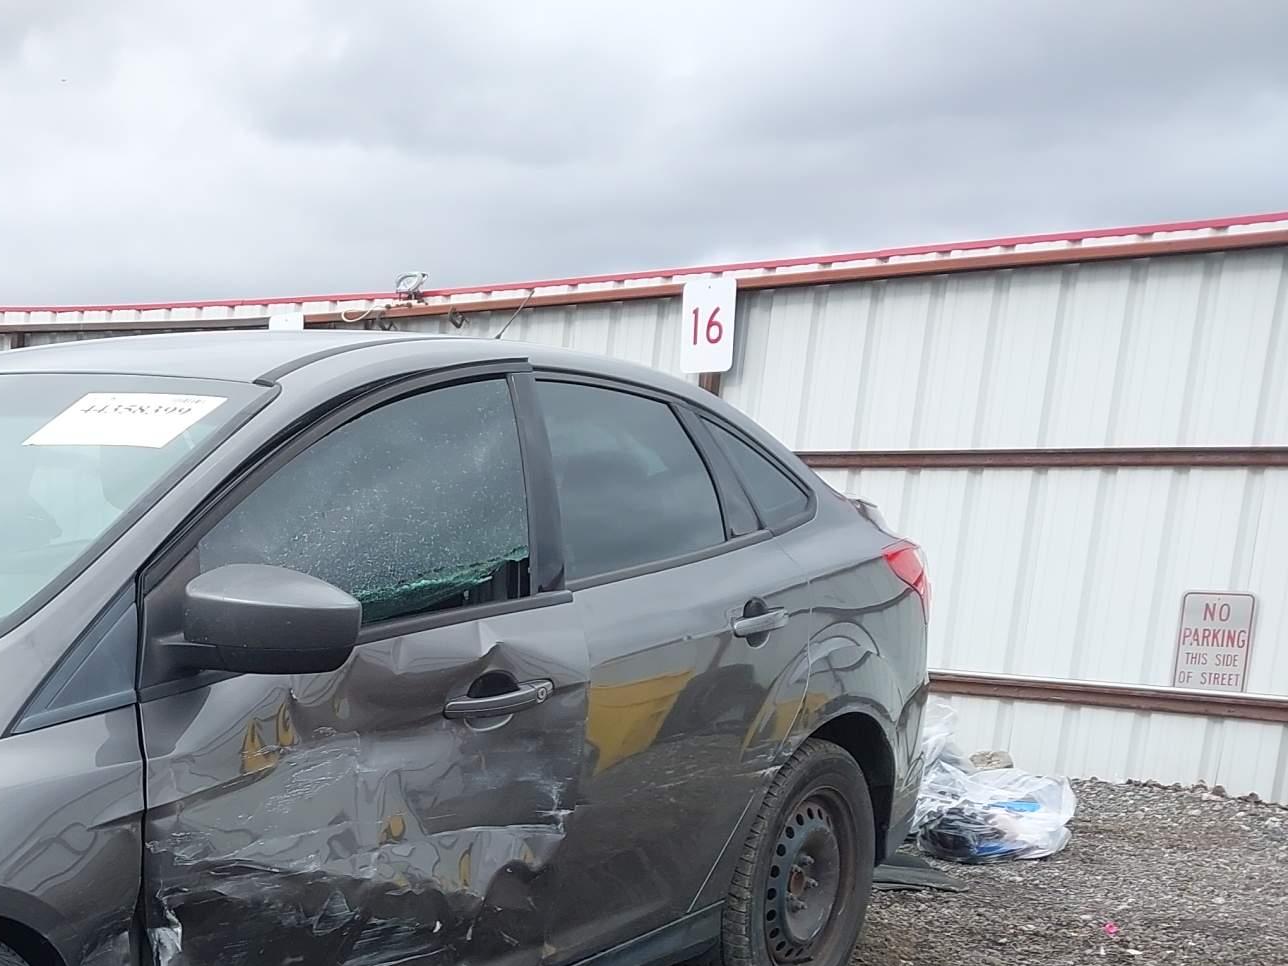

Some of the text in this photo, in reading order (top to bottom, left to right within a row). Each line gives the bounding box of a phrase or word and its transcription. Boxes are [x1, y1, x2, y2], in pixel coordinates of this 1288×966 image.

[692, 306, 723, 346] 16
[1202, 602, 1231, 622] NO
[1182, 627, 1247, 649] PARKING
[1185, 652, 1239, 667] THIS SIDE
[1178, 670, 1241, 687] OF STREET
